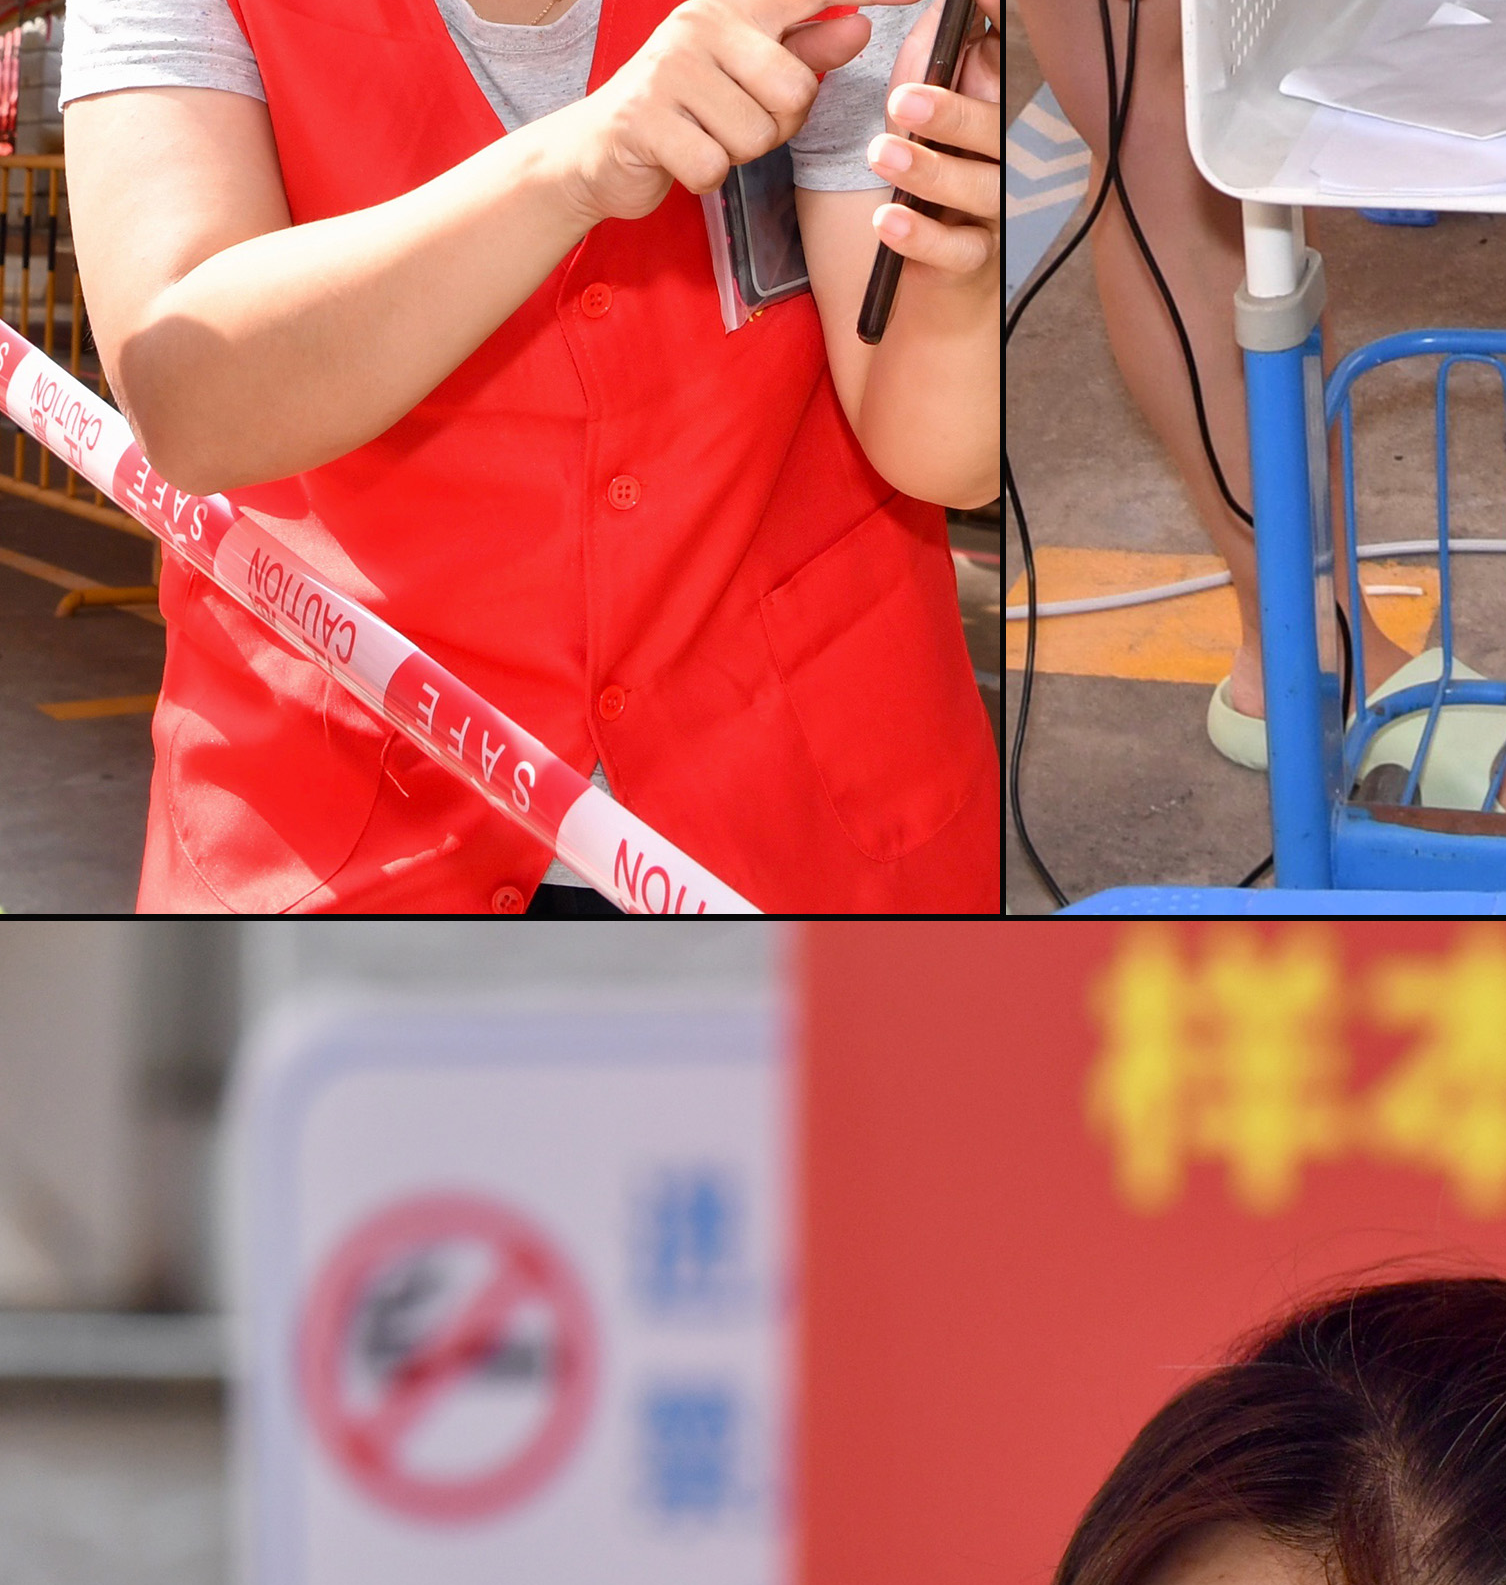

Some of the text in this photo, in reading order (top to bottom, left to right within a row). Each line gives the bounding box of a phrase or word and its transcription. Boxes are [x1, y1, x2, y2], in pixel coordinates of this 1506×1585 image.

[31, 372, 103, 451] CAUTION
[247, 547, 357, 665] CAUTION
[415, 682, 536, 813] SAFE
